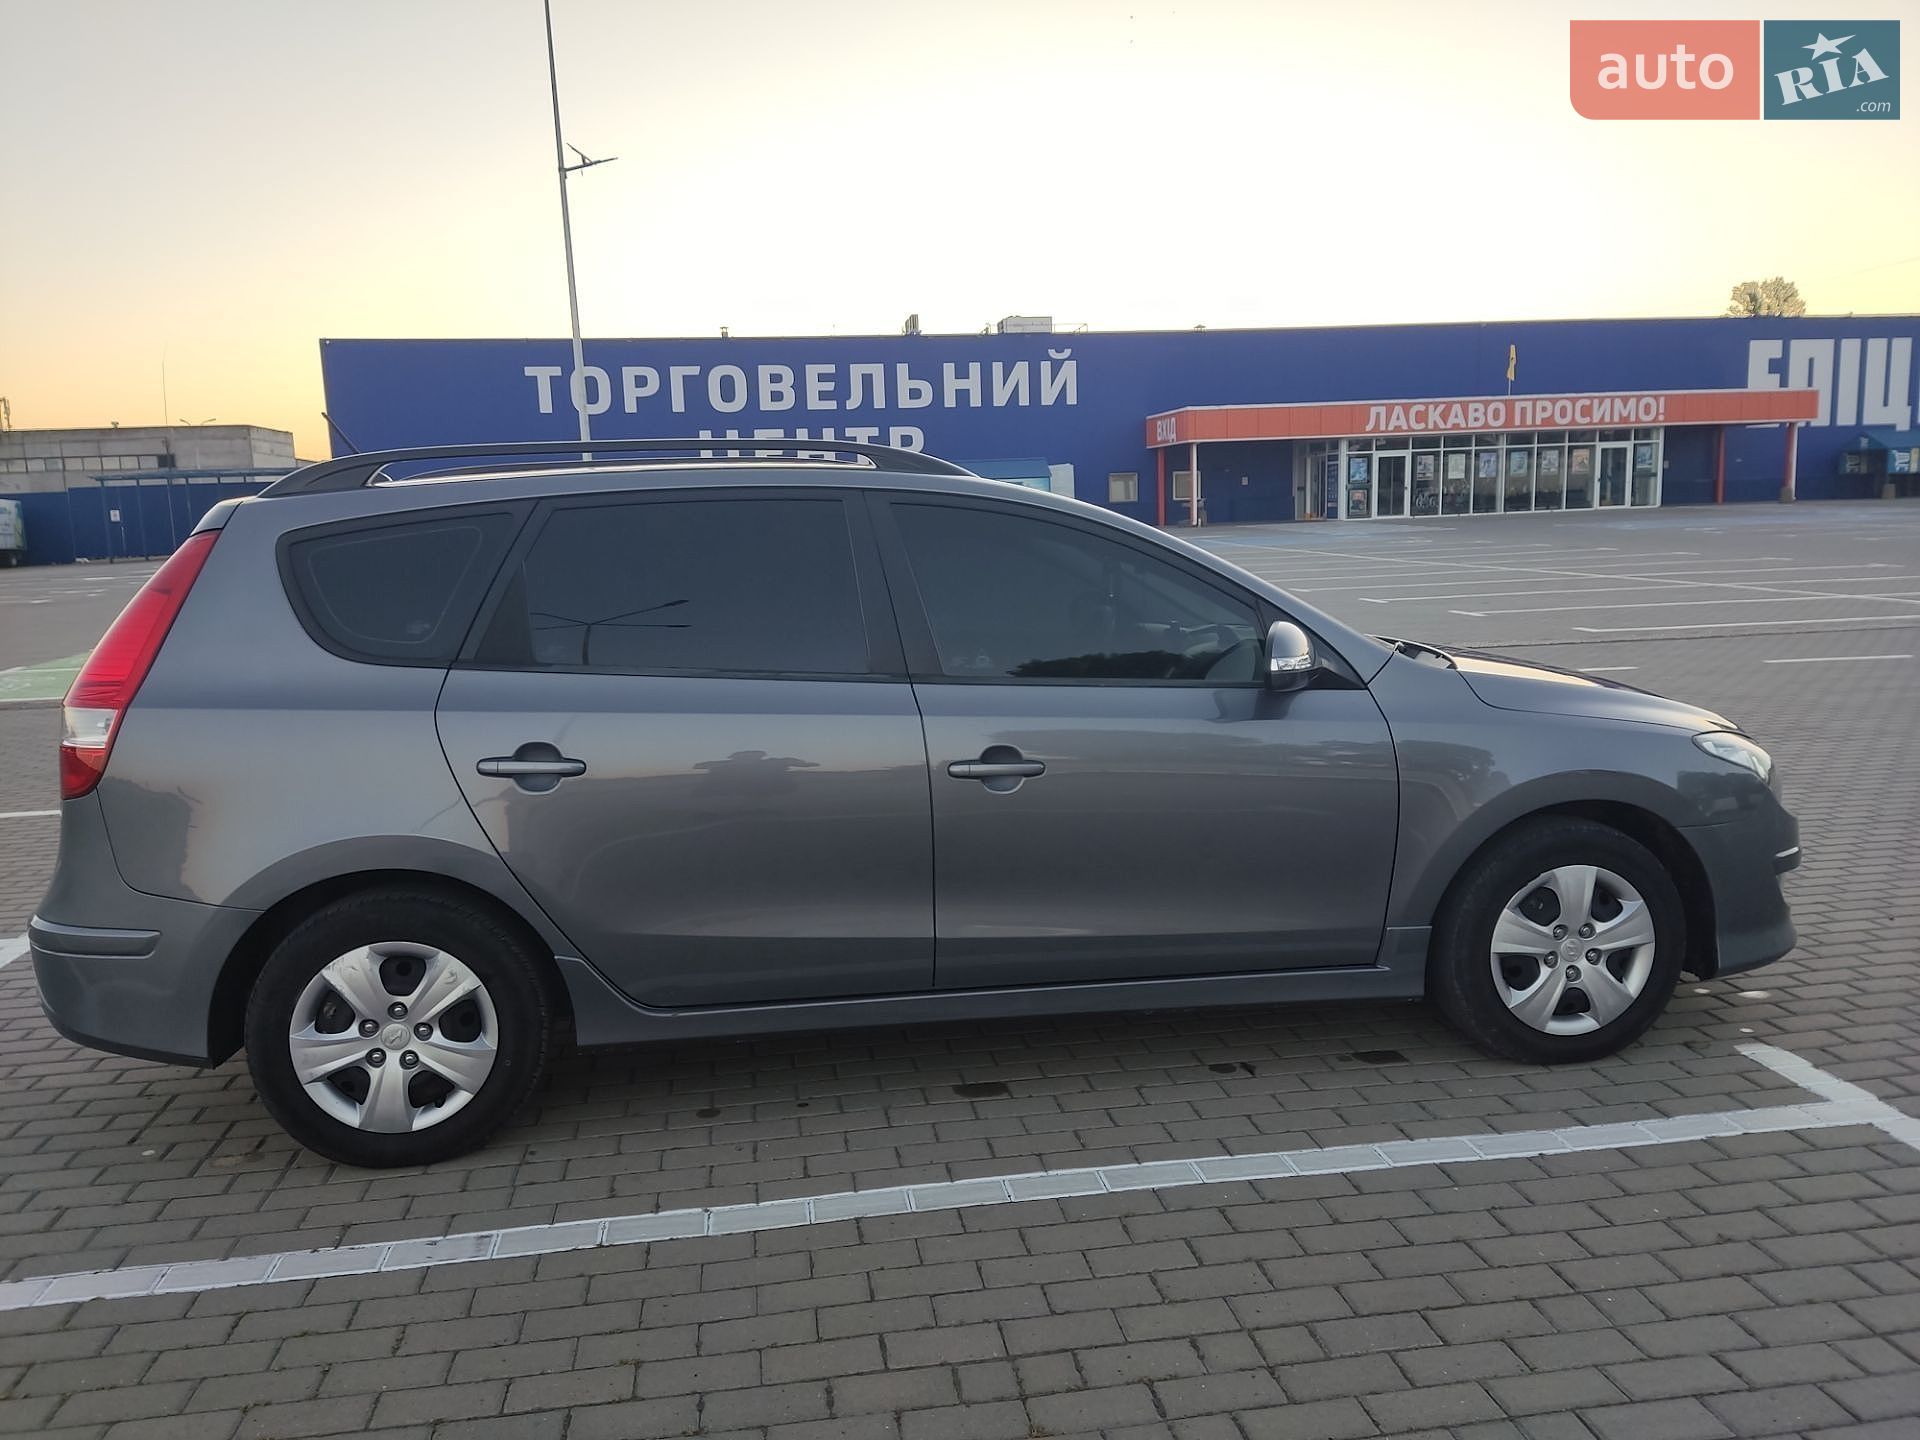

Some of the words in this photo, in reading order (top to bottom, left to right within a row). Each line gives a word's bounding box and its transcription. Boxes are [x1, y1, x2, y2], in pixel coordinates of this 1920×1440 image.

[524, 349, 1078, 414] ТОРГОВЕЛЬНИЙ
[1747, 338, 1920, 430] ЕПІЦ
[1156, 417, 1176, 443] ВХІД
[1366, 403, 1505, 432] ЛАСКАВО
[1514, 397, 1665, 426] ПРОСИМО!
